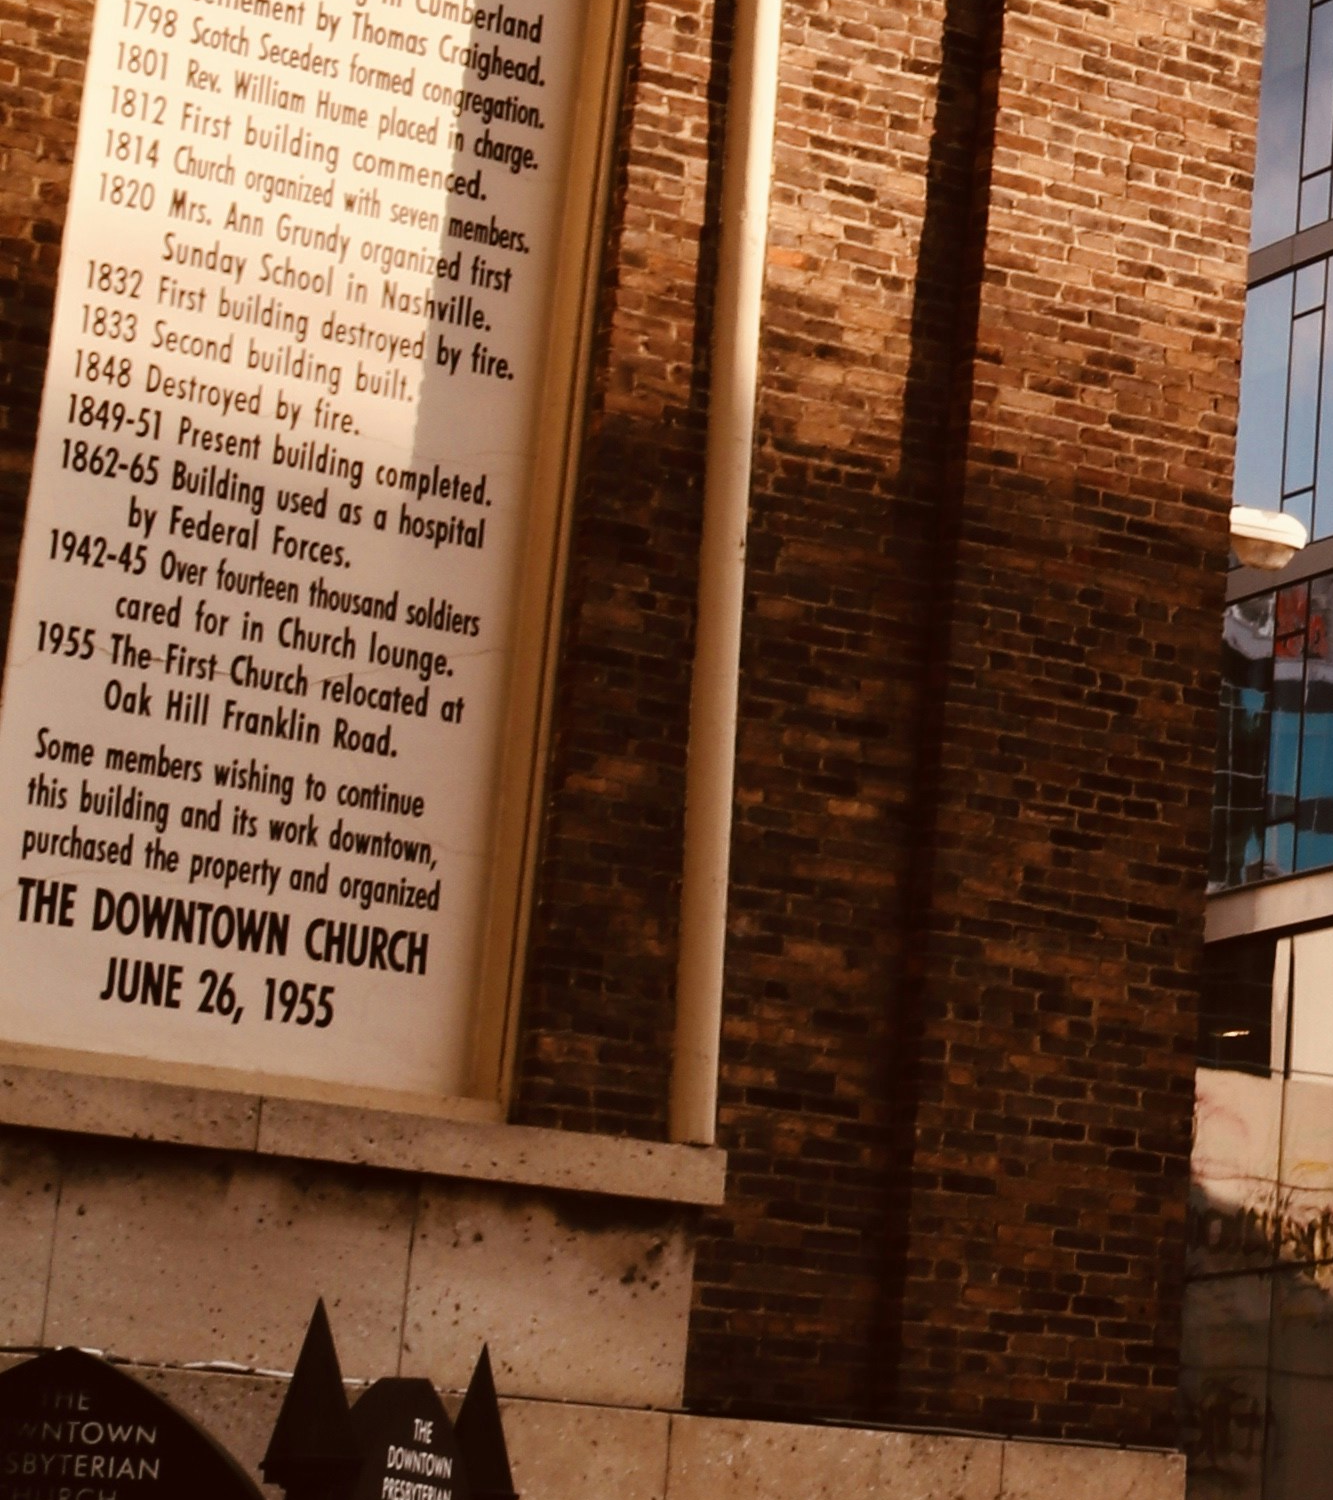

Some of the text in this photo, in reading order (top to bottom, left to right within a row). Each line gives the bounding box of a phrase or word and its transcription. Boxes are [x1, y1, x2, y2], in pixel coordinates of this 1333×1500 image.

[189, 15, 250, 57] Scotch
[257, 32, 340, 79] Seceders
[348, 52, 416, 98] formed
[422, 81, 545, 130] congregation.
[315, 1, 341, 42] by
[351, 10, 429, 57] Thomas
[438, 33, 546, 88] Craighead.
[112, 85, 488, 202] 1812 First building commenced.
[117, 41, 539, 176] 1801 Rev. William Hume placed in charge.
[100, 172, 513, 294] 1820 Mrs. Ann Grundy organized first
[106, 129, 530, 255] 1814 Church organized with seven members.
[87, 259, 515, 381] 1832 First building destroyed by fire.
[162, 231, 492, 333] Sunday School in Nashville.
[75, 348, 361, 436] 1848 Destroyed by fire.
[82, 303, 413, 402] 1833 Second building built.
[61, 437, 487, 550] 1862-65 Building used as a hospital
[67, 392, 492, 507] 1849-51 Present building completed.
[127, 494, 351, 569] by Federal Forces.
[49, 527, 481, 638] 1942-45 Over fourteen thousand soldiers
[37, 620, 466, 725] 1955 The First Church relocated at
[115, 595, 454, 683] cared for in Church lounge.
[103, 678, 398, 759] Oak Hill Franklin Road.
[27, 771, 438, 872] this building and its work downtown,
[34, 726, 426, 819] Some members wishing to continue
[21, 824, 442, 912] purchased the property and organized
[17, 876, 430, 976] THE DOWNTOWN CHURCH
[98, 956, 336, 1029] JUNE 26, 1955
[386, 1445, 453, 1480] DOWNTOWN
[413, 1418, 434, 1445] THE
